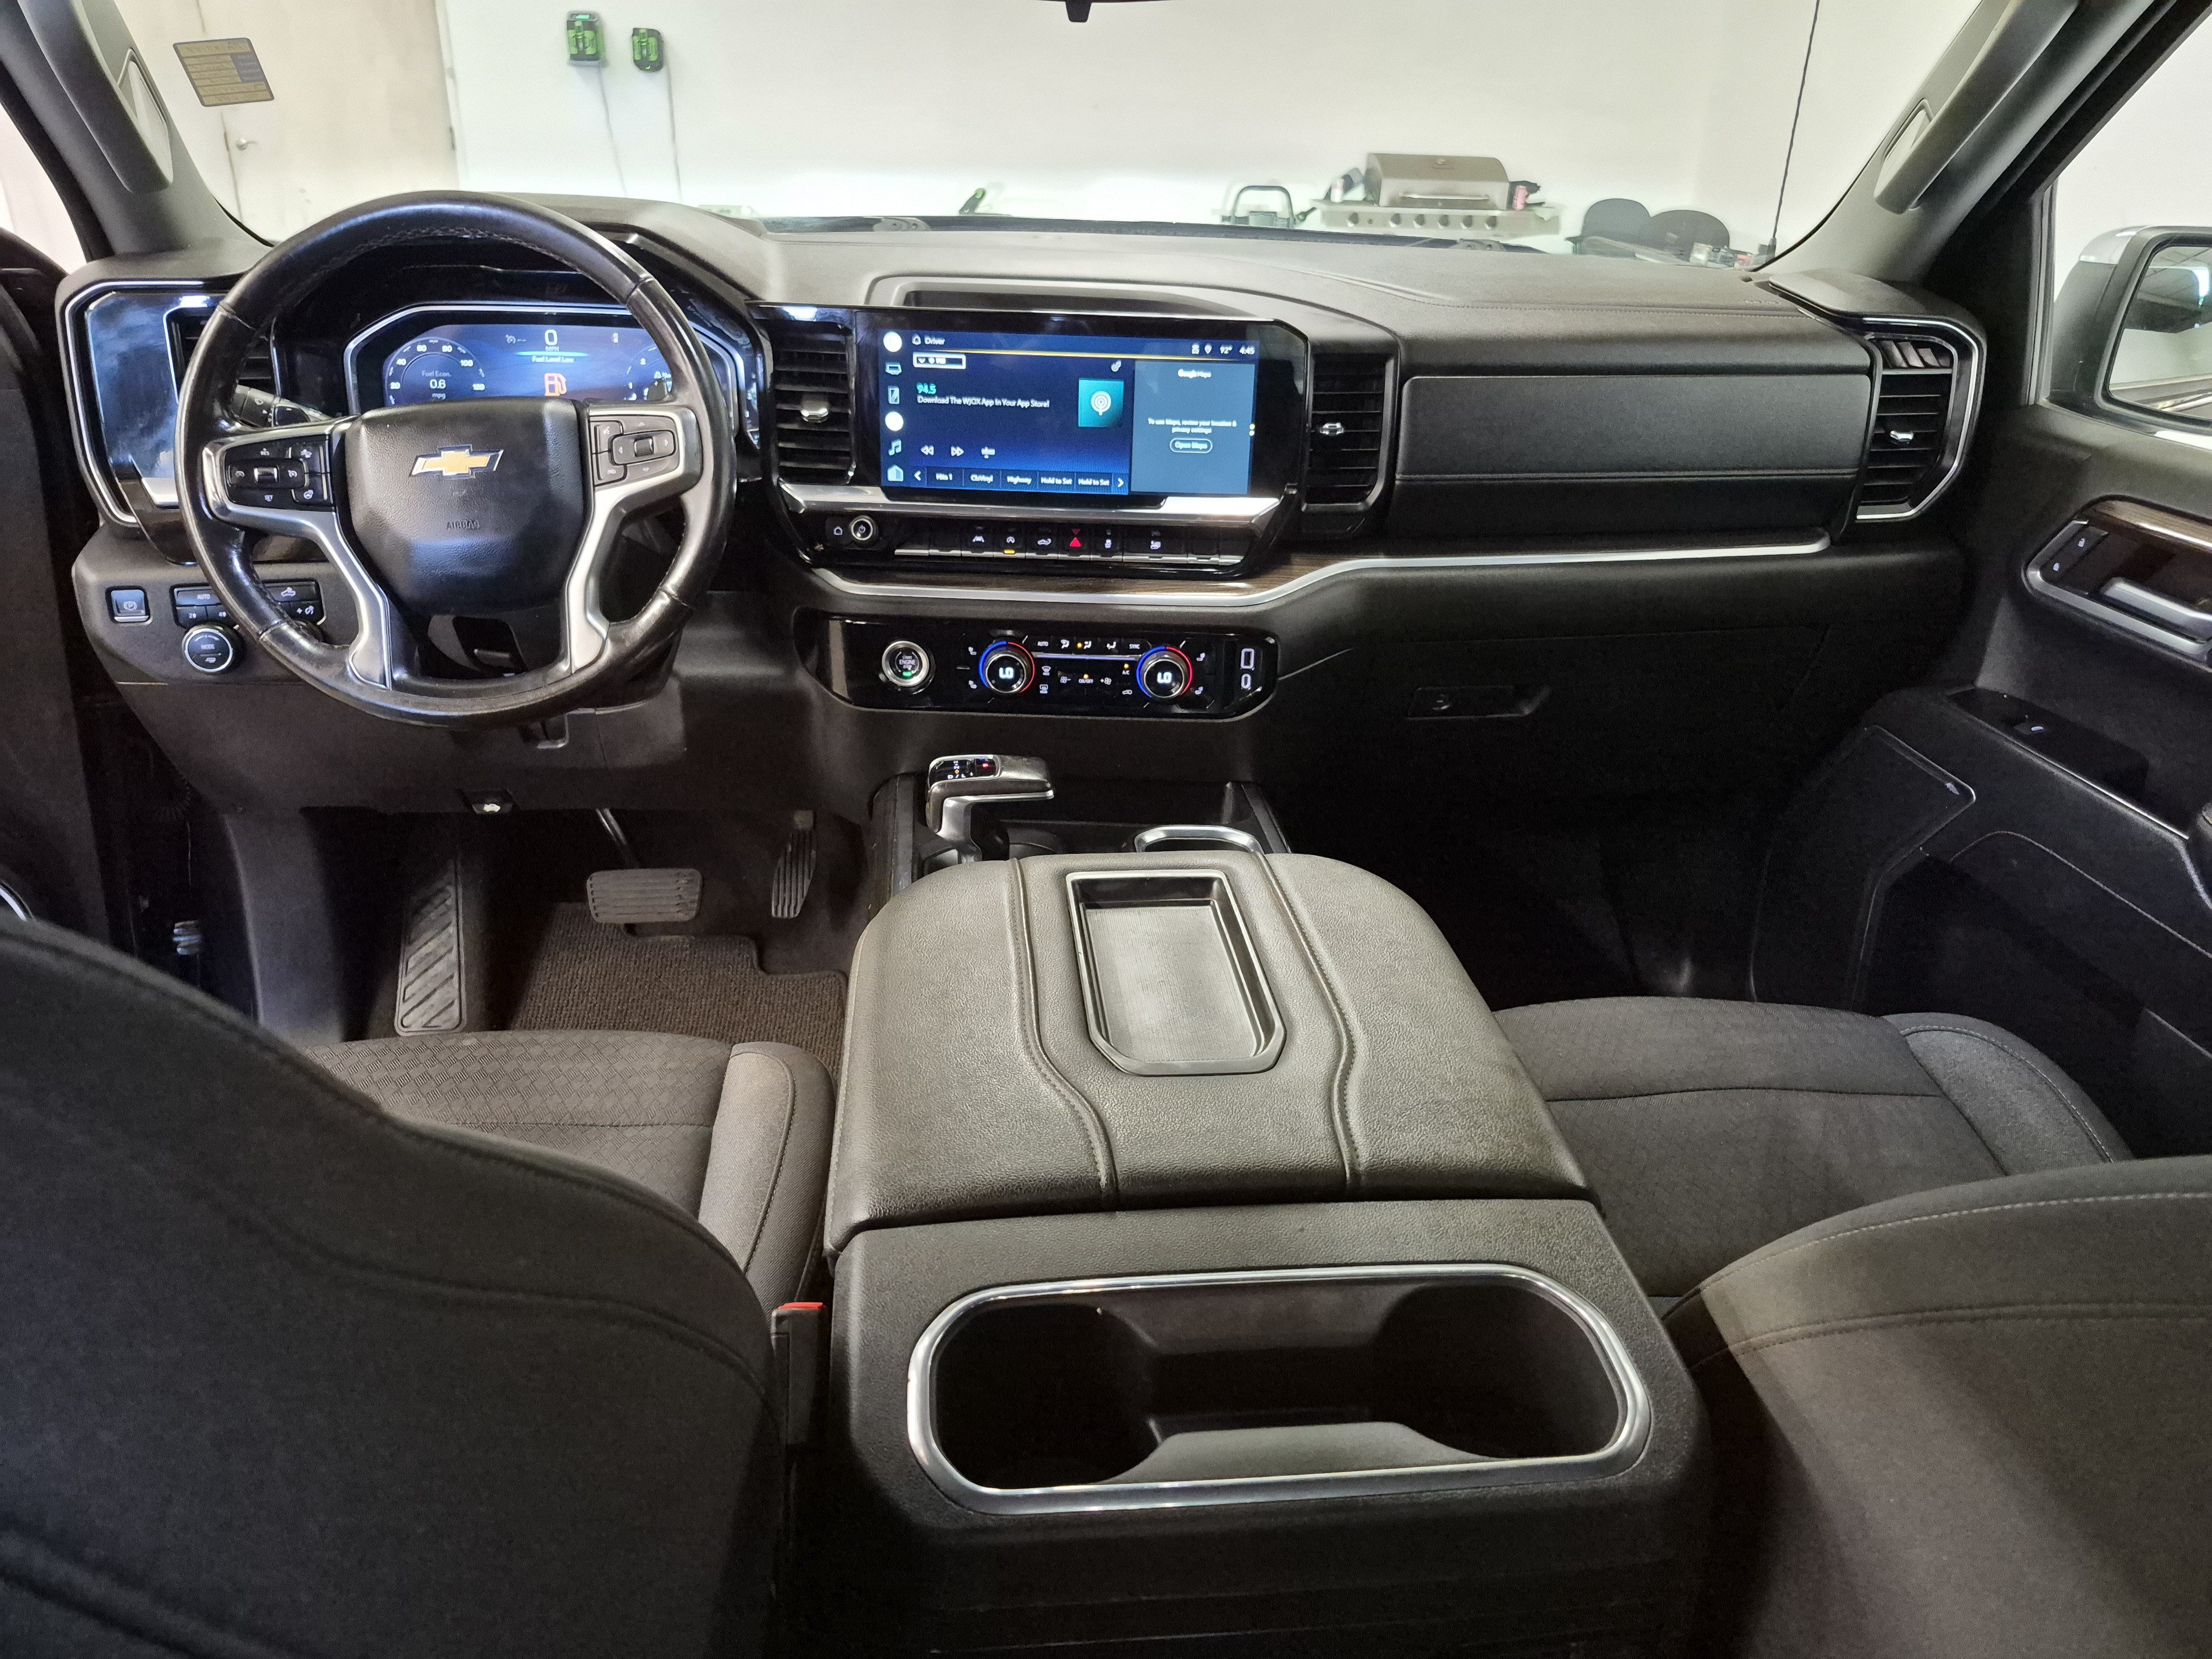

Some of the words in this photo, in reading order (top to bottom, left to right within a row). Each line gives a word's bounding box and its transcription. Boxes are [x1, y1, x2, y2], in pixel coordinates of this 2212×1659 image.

[544, 329, 558, 346] 0
[924, 336, 945, 345] Driver
[917, 395, 949, 404] Download
[950, 396, 962, 405] The
[962, 397, 982, 406] WJOX
[982, 397, 994, 407] App
[1001, 398, 1016, 406] Your
[1017, 398, 1030, 408] App
[1030, 399, 1050, 408] Store!
[446, 519, 479, 531] AIRBAG
